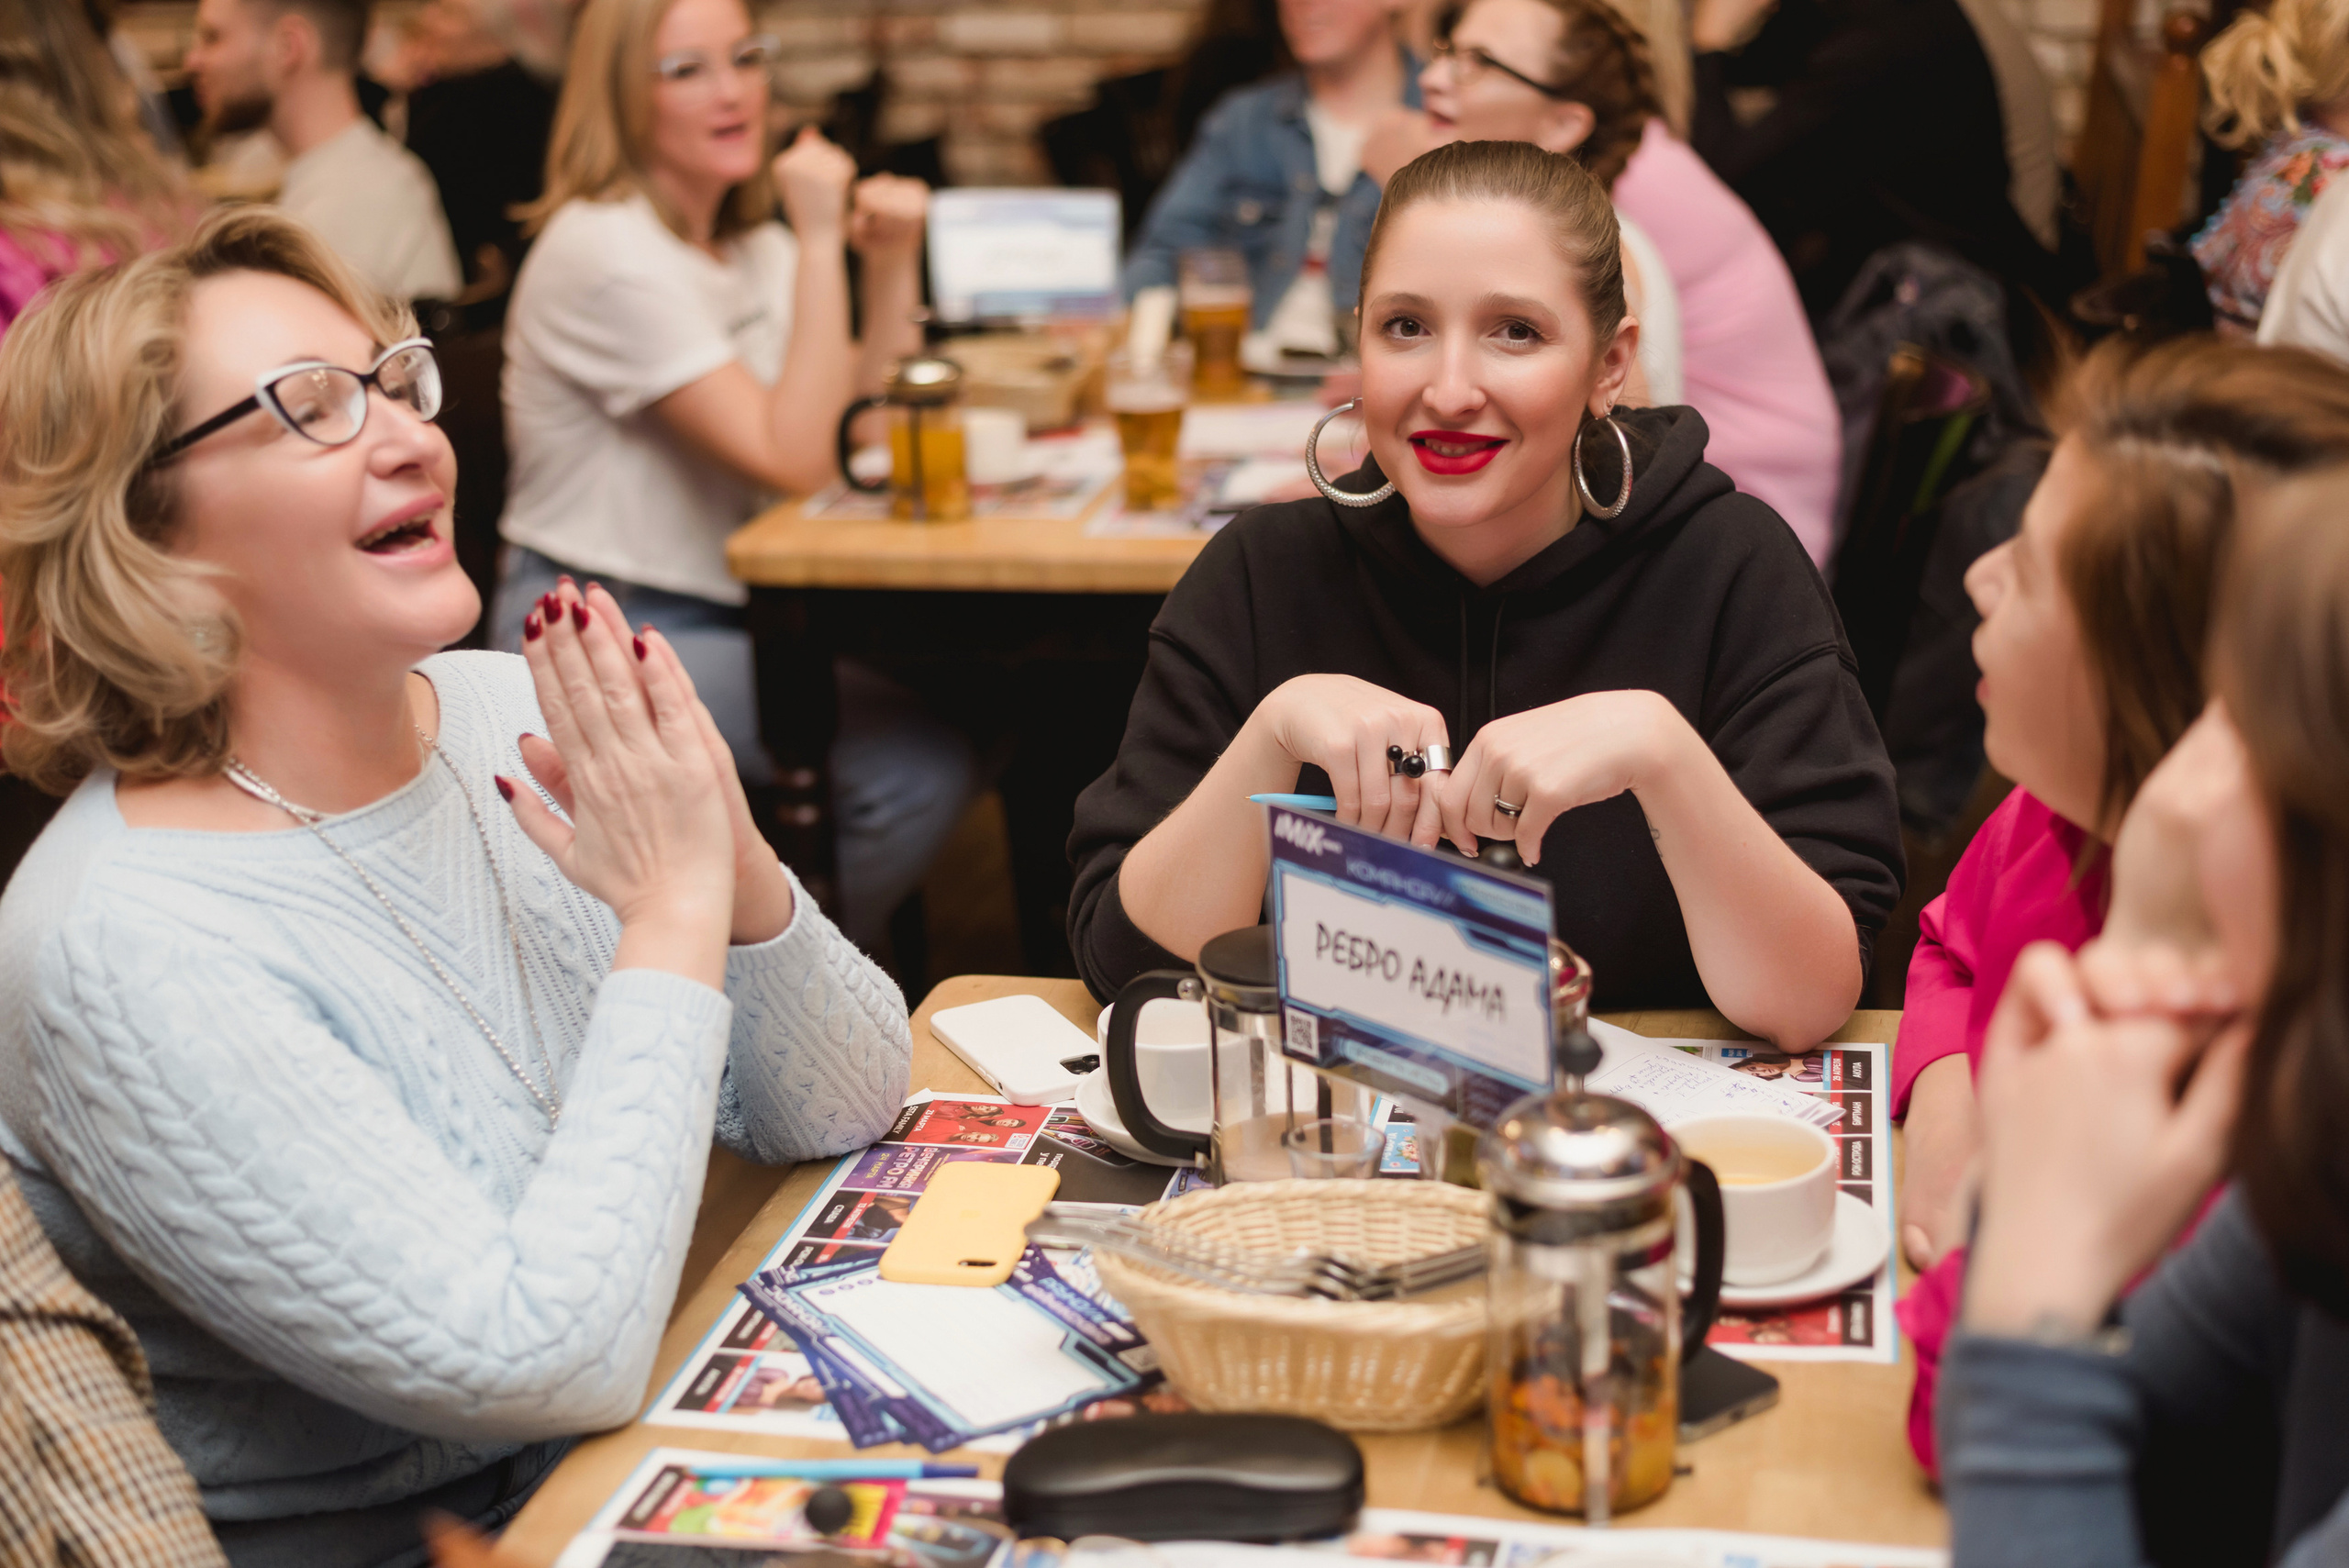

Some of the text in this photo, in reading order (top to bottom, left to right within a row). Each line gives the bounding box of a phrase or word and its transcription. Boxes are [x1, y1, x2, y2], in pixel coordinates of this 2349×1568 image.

[1315, 920, 1508, 1024] РЕБРО АДАМА
[1832, 1058, 1841, 1074] АПРЕЛЯ
[1852, 1062, 1862, 1079] АКУЛА
[892, 1116, 911, 1135] FAMILY
[913, 1115, 930, 1132] МАРТА
[865, 1161, 885, 1179] МАРТА
[886, 1146, 919, 1175] РЕТРО
[897, 1147, 939, 1189] ВЕЧЕРИНКА
[824, 1204, 844, 1224] СЛАВА
[841, 1208, 863, 1229] АПРЕЛЯ
